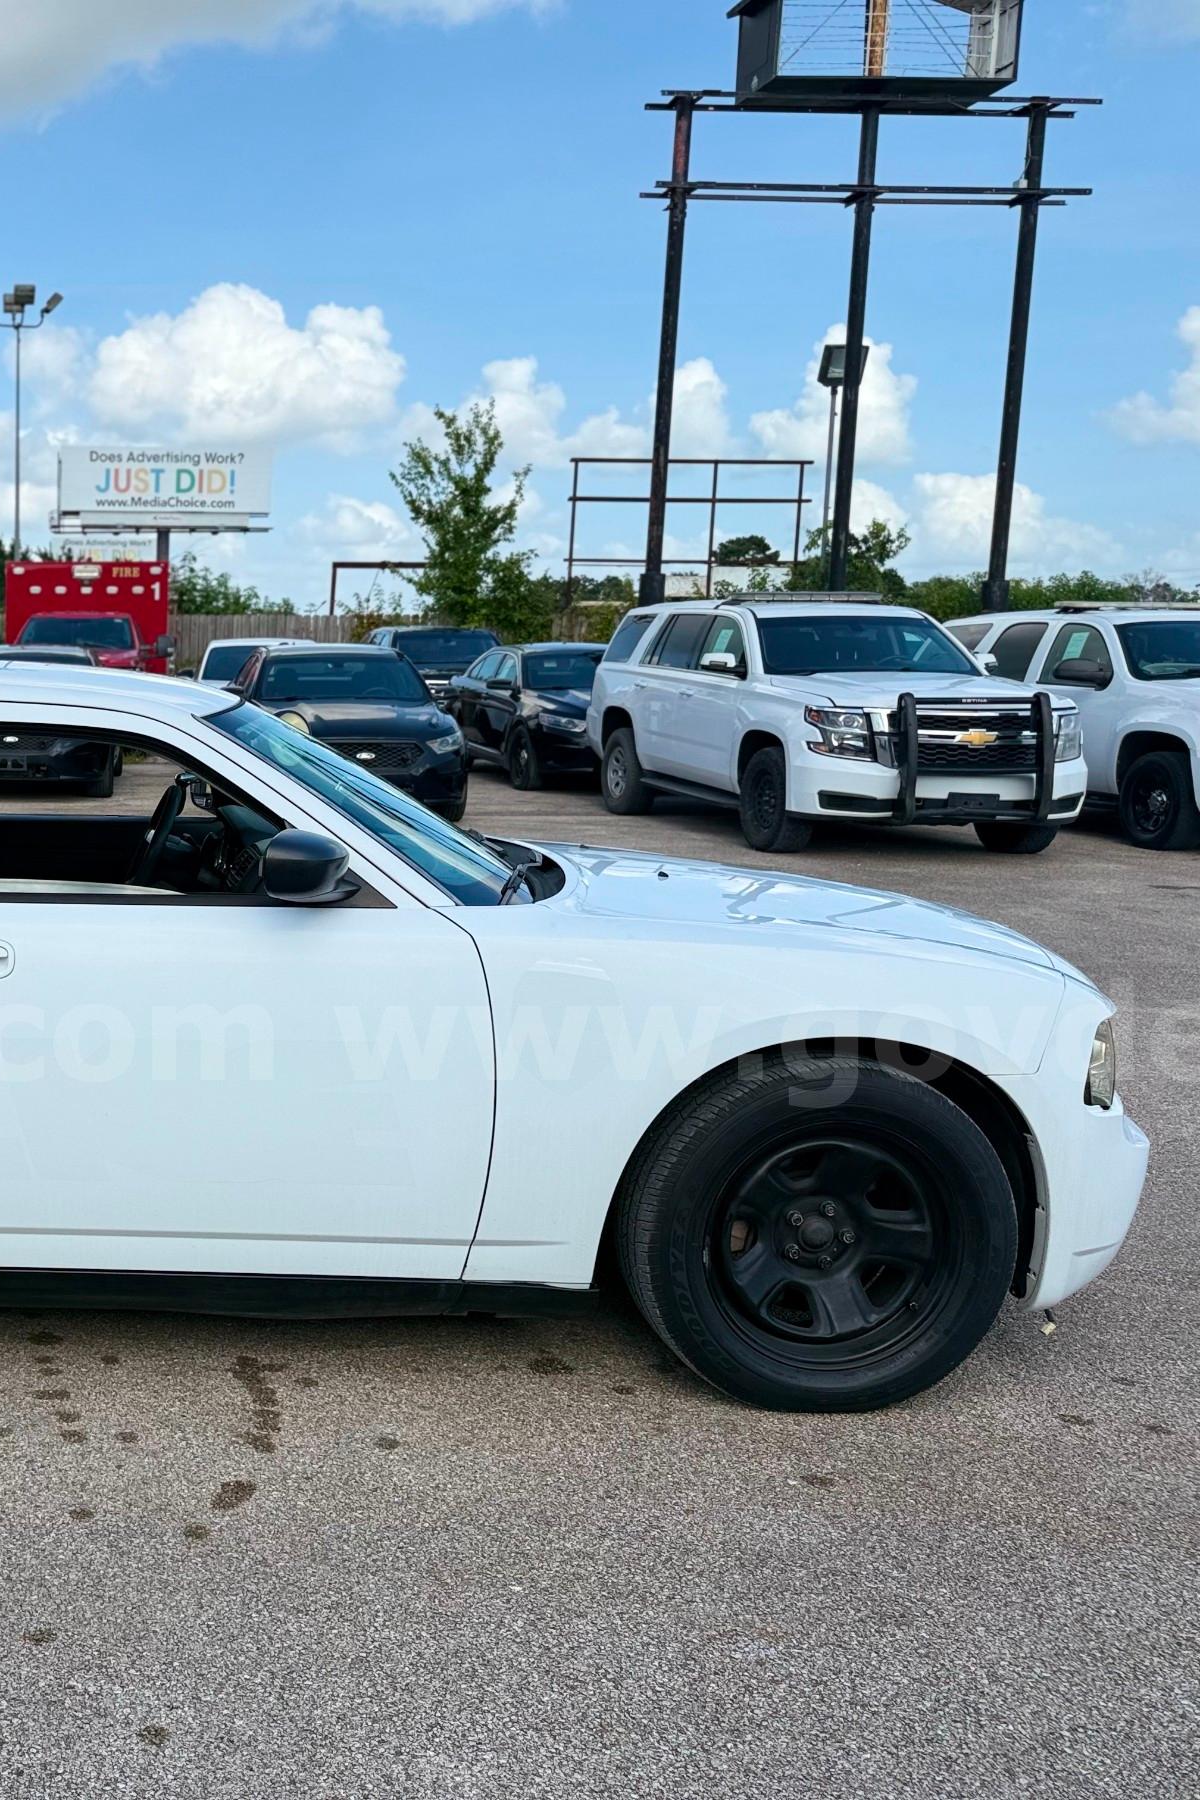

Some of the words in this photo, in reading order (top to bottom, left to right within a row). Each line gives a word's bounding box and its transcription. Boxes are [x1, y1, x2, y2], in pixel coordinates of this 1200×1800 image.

[89, 451, 123, 463] Does
[126, 451, 201, 467] Advertising
[204, 452, 245, 465] Work?
[95, 468, 165, 493] JUST
[175, 468, 236, 494] DID!
[95, 496, 236, 509] www.MediaChoice.com
[112, 567, 140, 578] FIRE
[150, 581, 161, 601] 1
